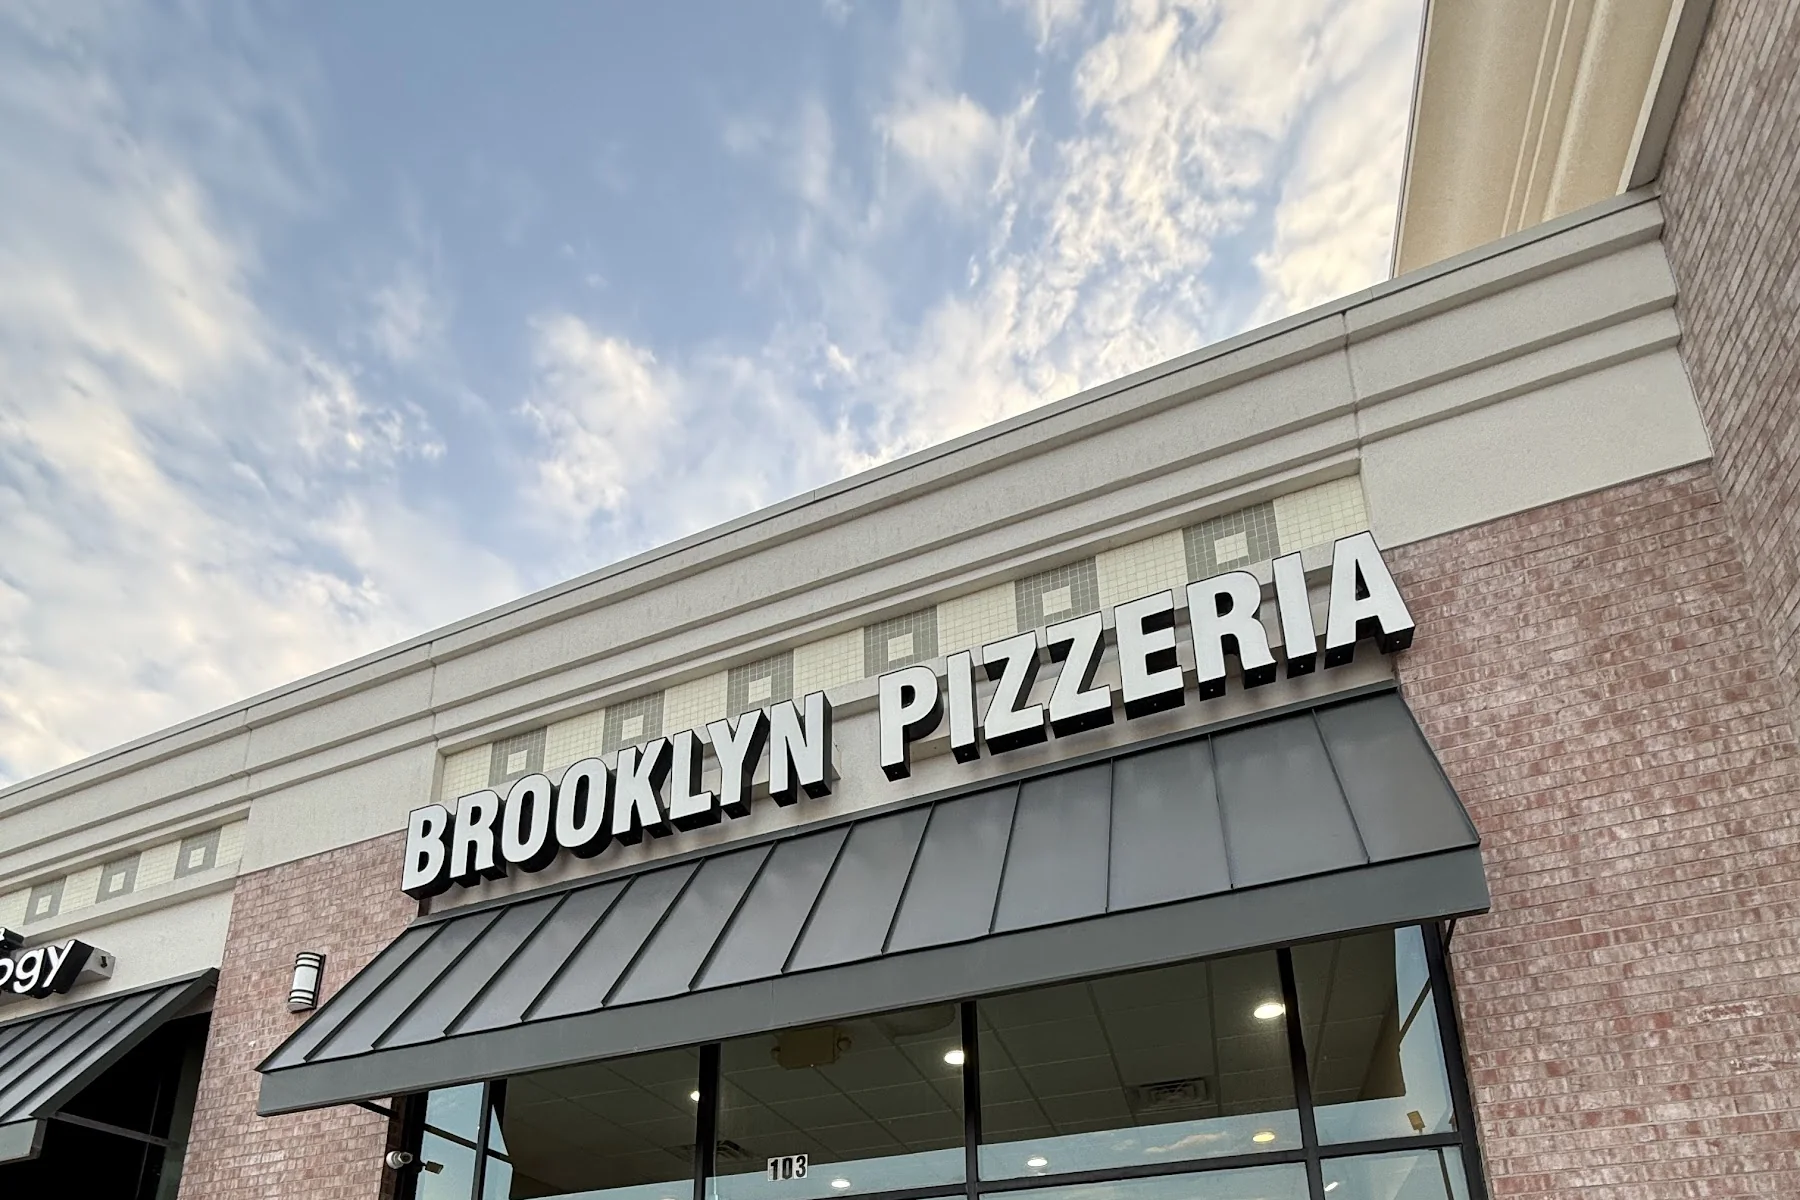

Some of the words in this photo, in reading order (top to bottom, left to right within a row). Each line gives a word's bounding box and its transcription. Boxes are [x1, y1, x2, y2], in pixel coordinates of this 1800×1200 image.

[401, 691, 832, 896] BROOKLYN
[878, 531, 1414, 780] PIZZERIA
[770, 1155, 806, 1180] 103
